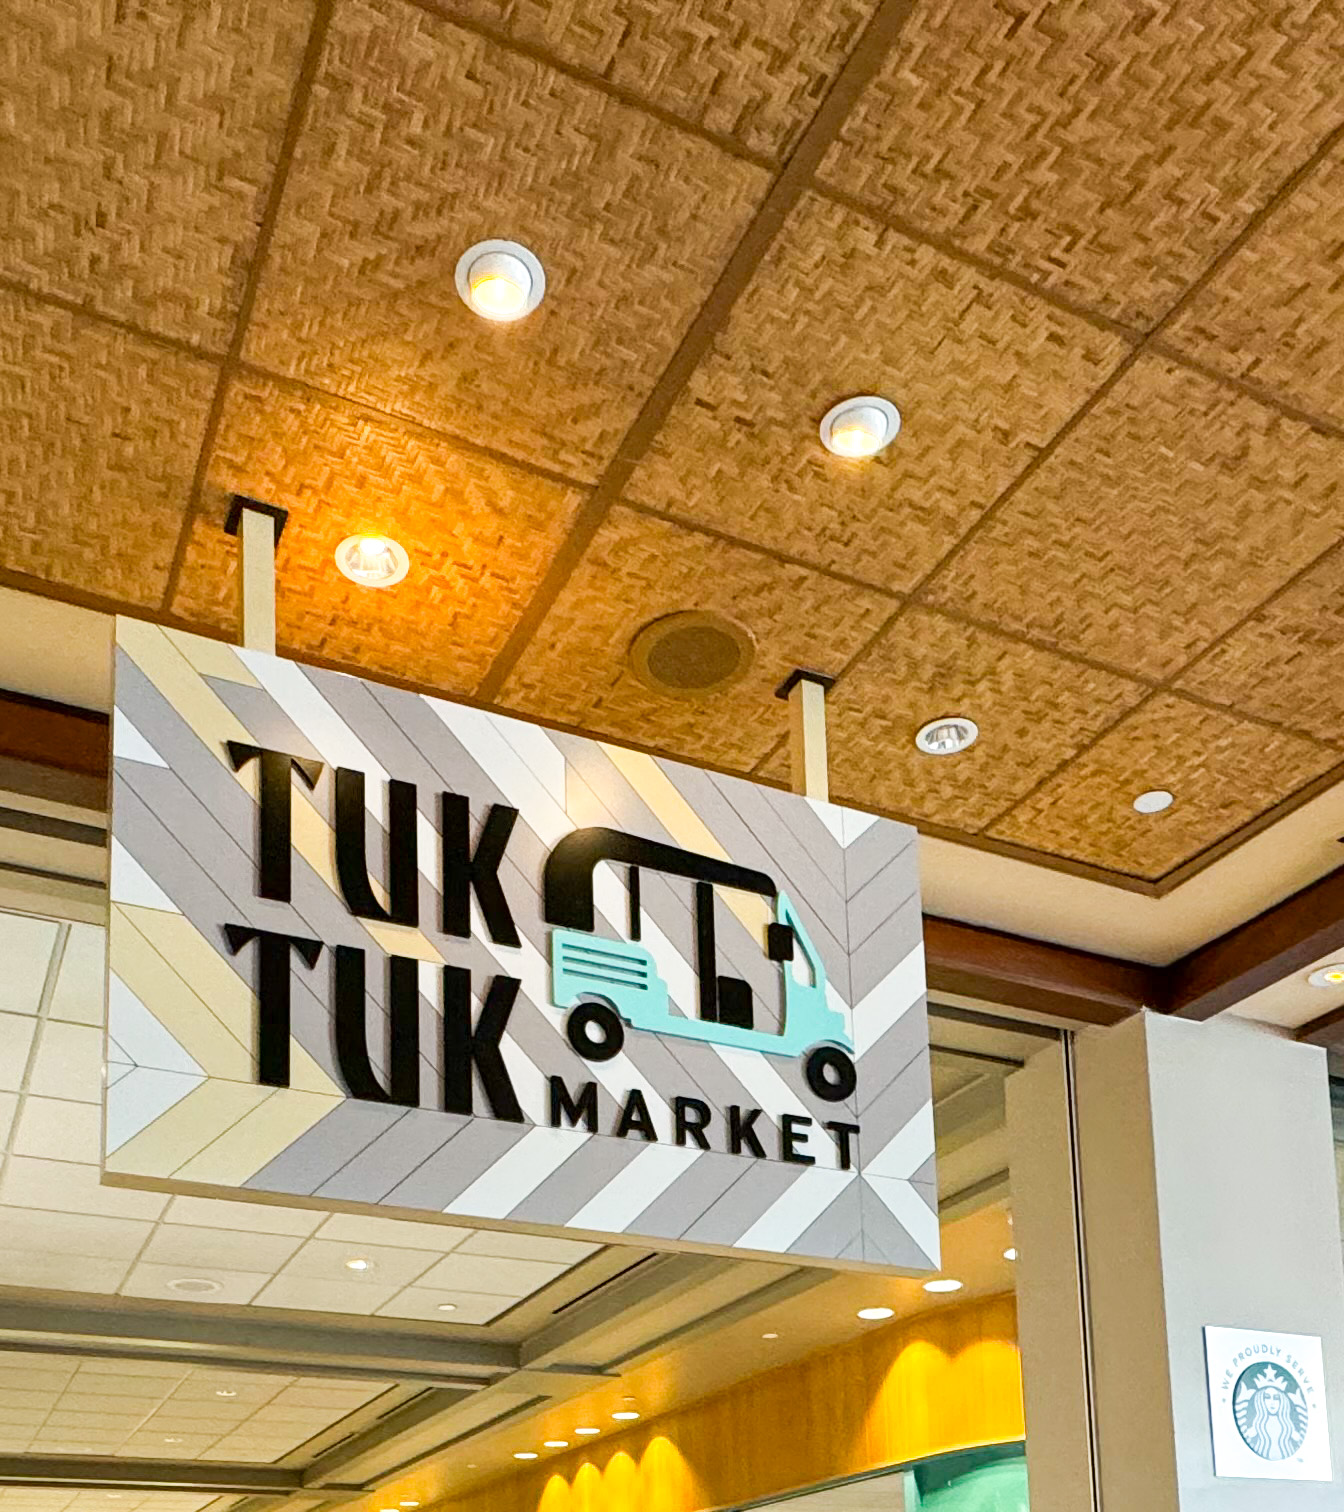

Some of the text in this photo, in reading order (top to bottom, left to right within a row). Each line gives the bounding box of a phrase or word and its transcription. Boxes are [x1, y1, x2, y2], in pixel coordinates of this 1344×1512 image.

[225, 739, 521, 949] TUK
[223, 923, 524, 1123] TUK
[548, 1074, 861, 1172] MARKET
[1221, 1344, 1315, 1394] WE PROUDLY SERVE
